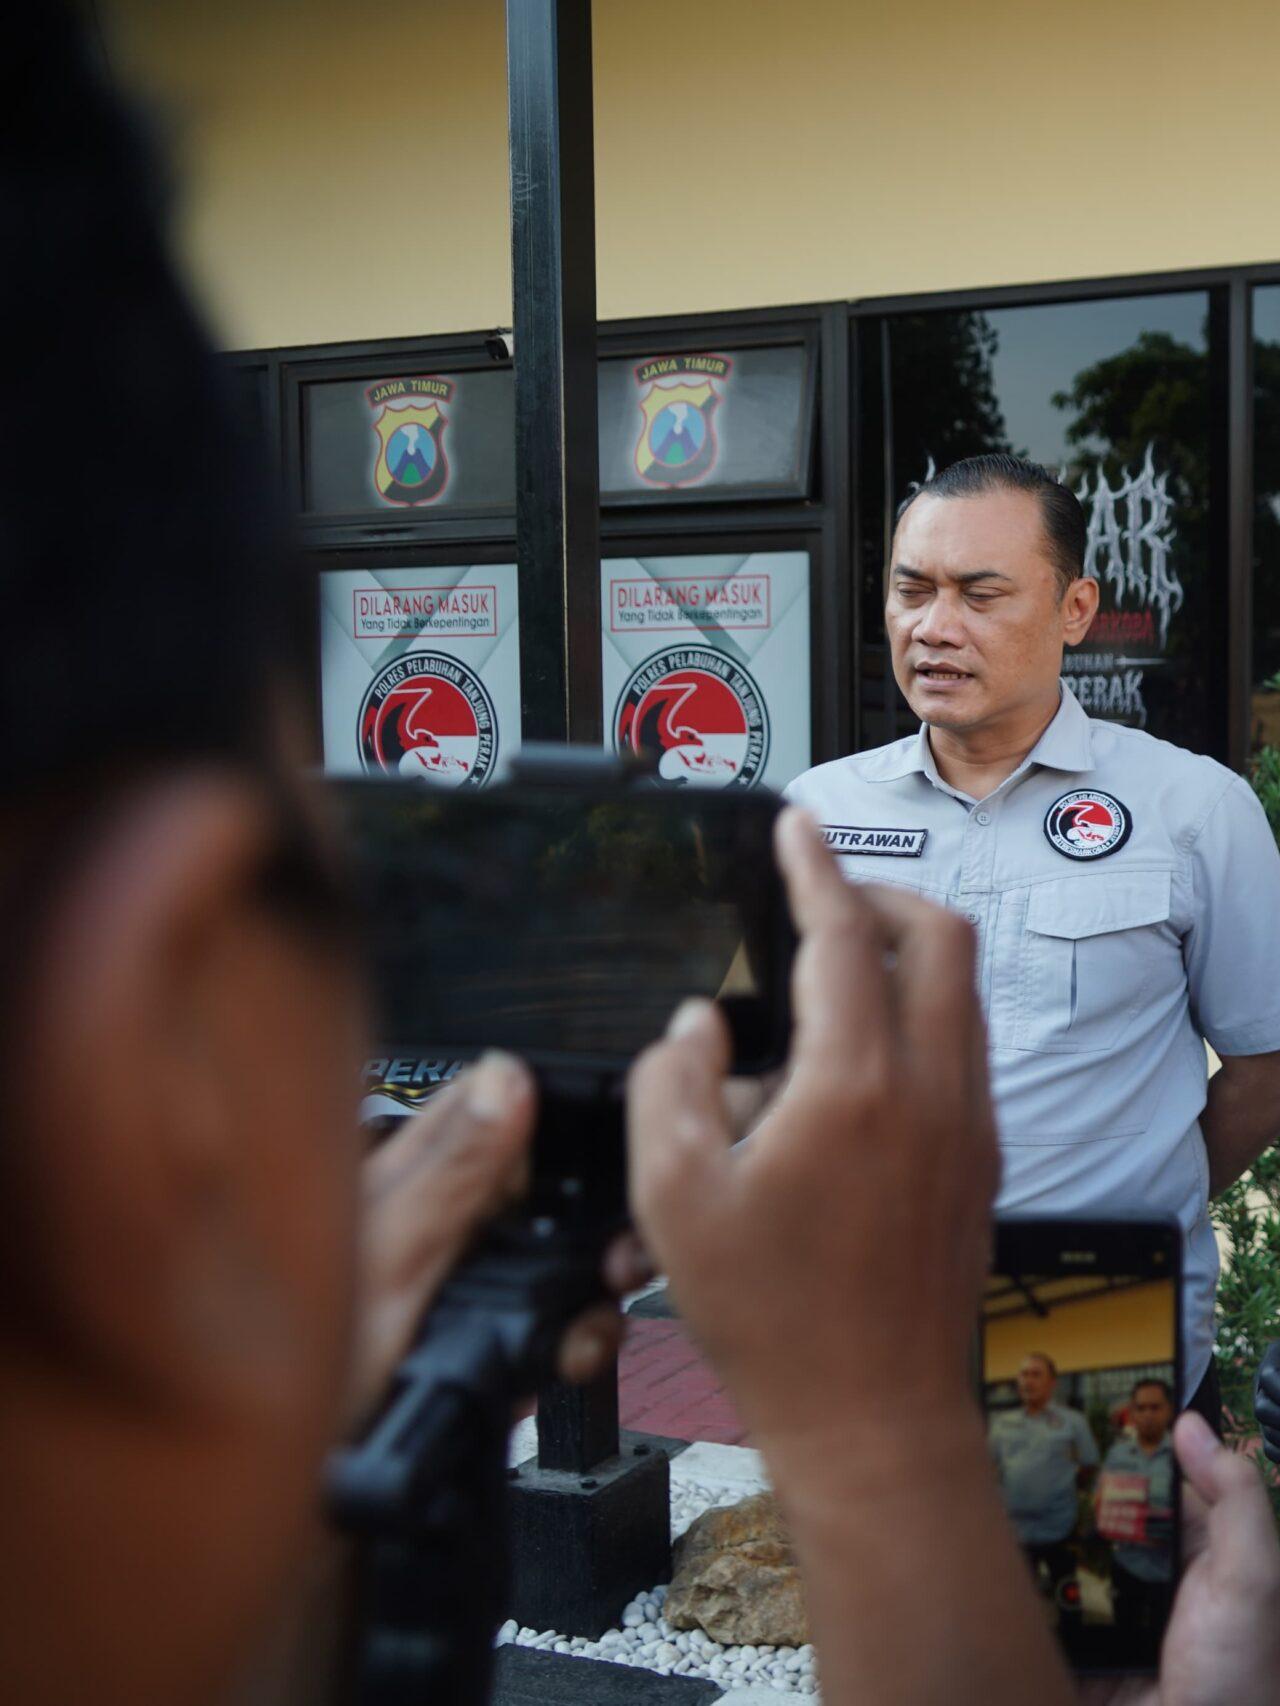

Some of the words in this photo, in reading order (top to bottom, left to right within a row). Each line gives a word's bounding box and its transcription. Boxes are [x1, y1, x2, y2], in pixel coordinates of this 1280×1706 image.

[642, 358, 678, 380] JAWA
[683, 357, 725, 374] TIMUR
[374, 382, 406, 402] JAWA
[411, 379, 448, 396] TIMUR
[360, 594, 435, 616] DILARANG
[438, 592, 489, 614] MASUK
[617, 585, 701, 608] DILARANG
[704, 583, 762, 605] MASUK
[361, 618, 385, 632] Yang
[387, 618, 411, 630] Tidak
[414, 616, 489, 631] Berkepentingan
[618, 610, 645, 624] Yang
[647, 609, 674, 621] Tidak
[374, 665, 406, 700] POLRES
[406, 658, 466, 683] PELABUHAN
[632, 659, 670, 697] POLRES
[461, 677, 491, 730] TANJUNG
[475, 732, 493, 773] PERAK
